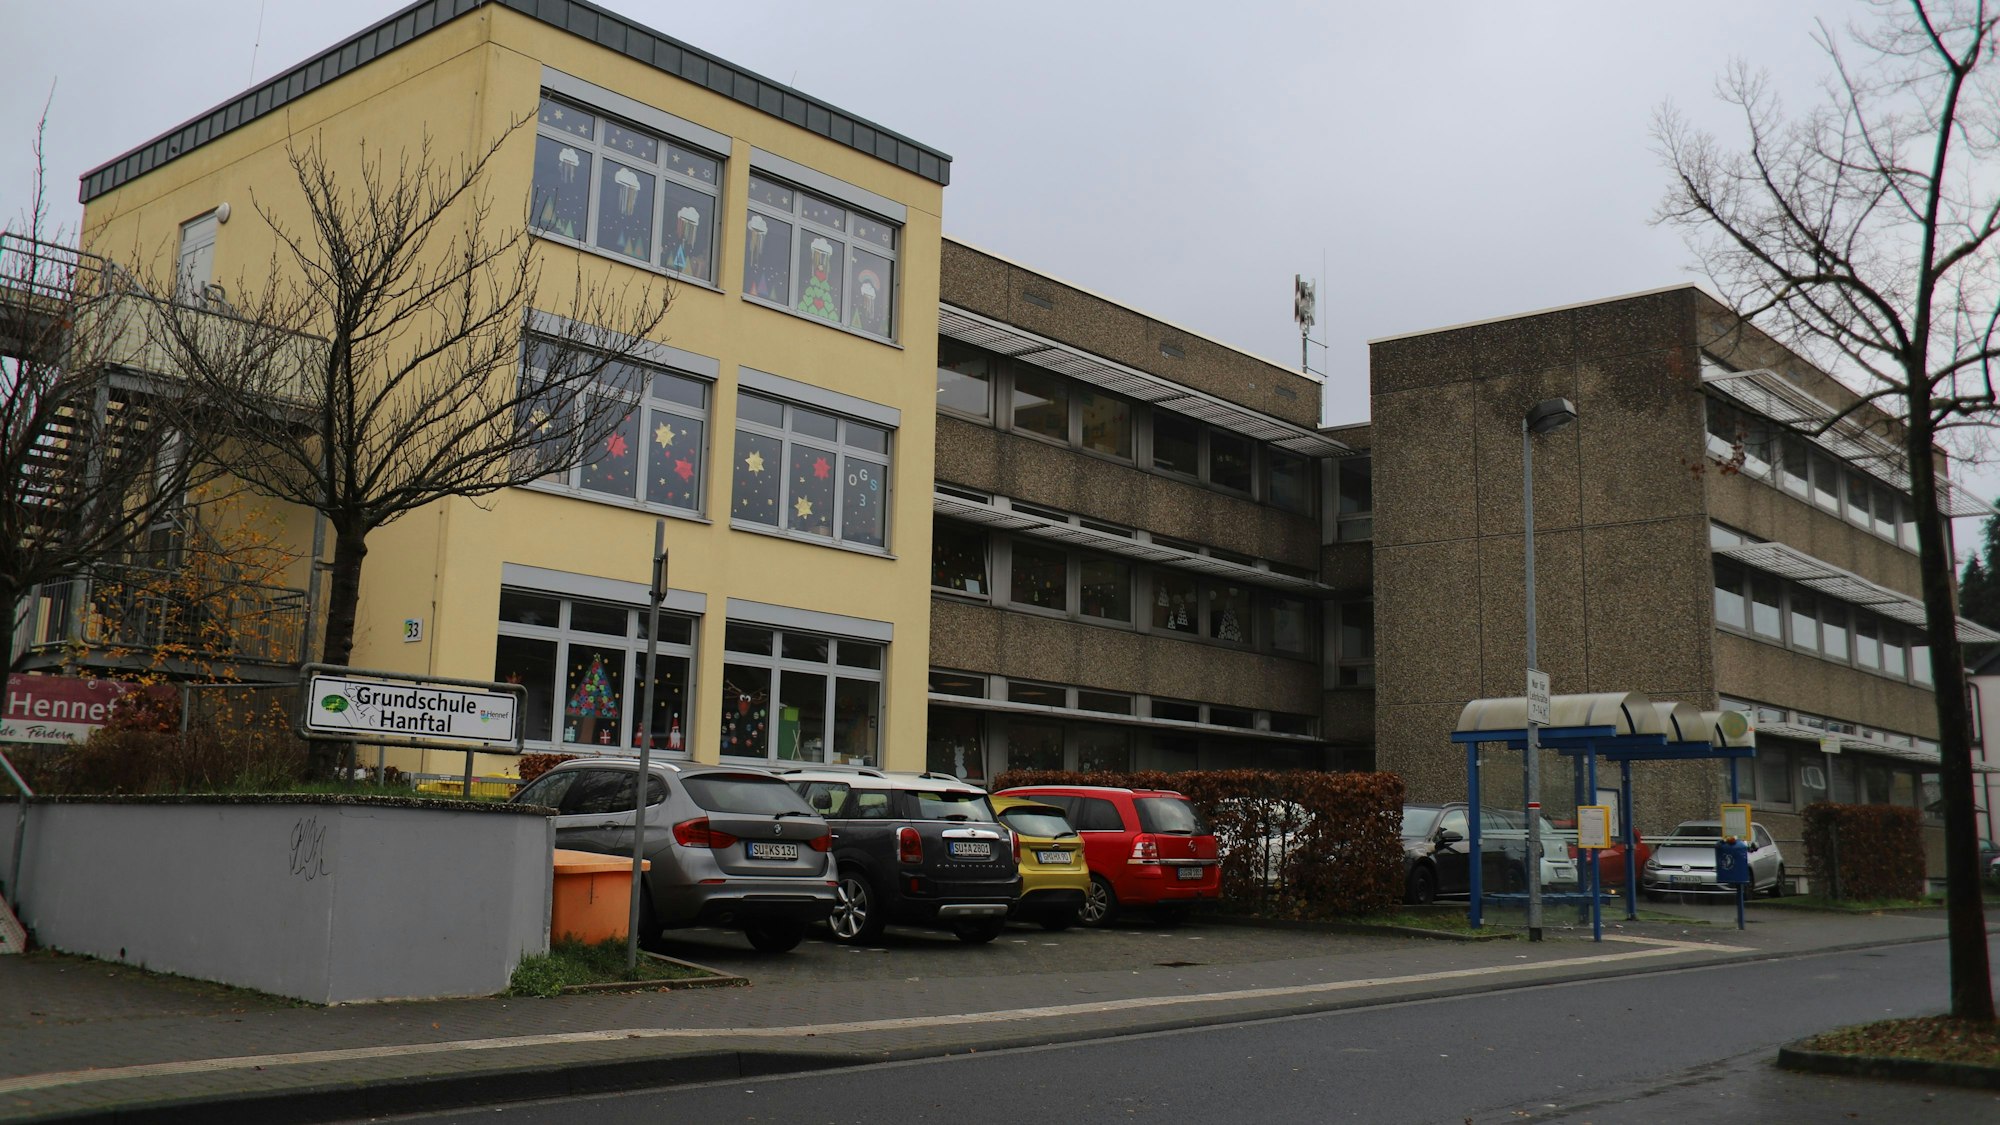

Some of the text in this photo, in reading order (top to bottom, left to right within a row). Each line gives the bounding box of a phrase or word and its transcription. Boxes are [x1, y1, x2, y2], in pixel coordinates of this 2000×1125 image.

[407, 622, 419, 638] 33
[8, 691, 118, 720] Hennef
[356, 686, 477, 715] Grundschule
[380, 709, 452, 733] Hanftal
[487, 710, 509, 719] Hennef
[26, 725, 74, 740] Fördern
